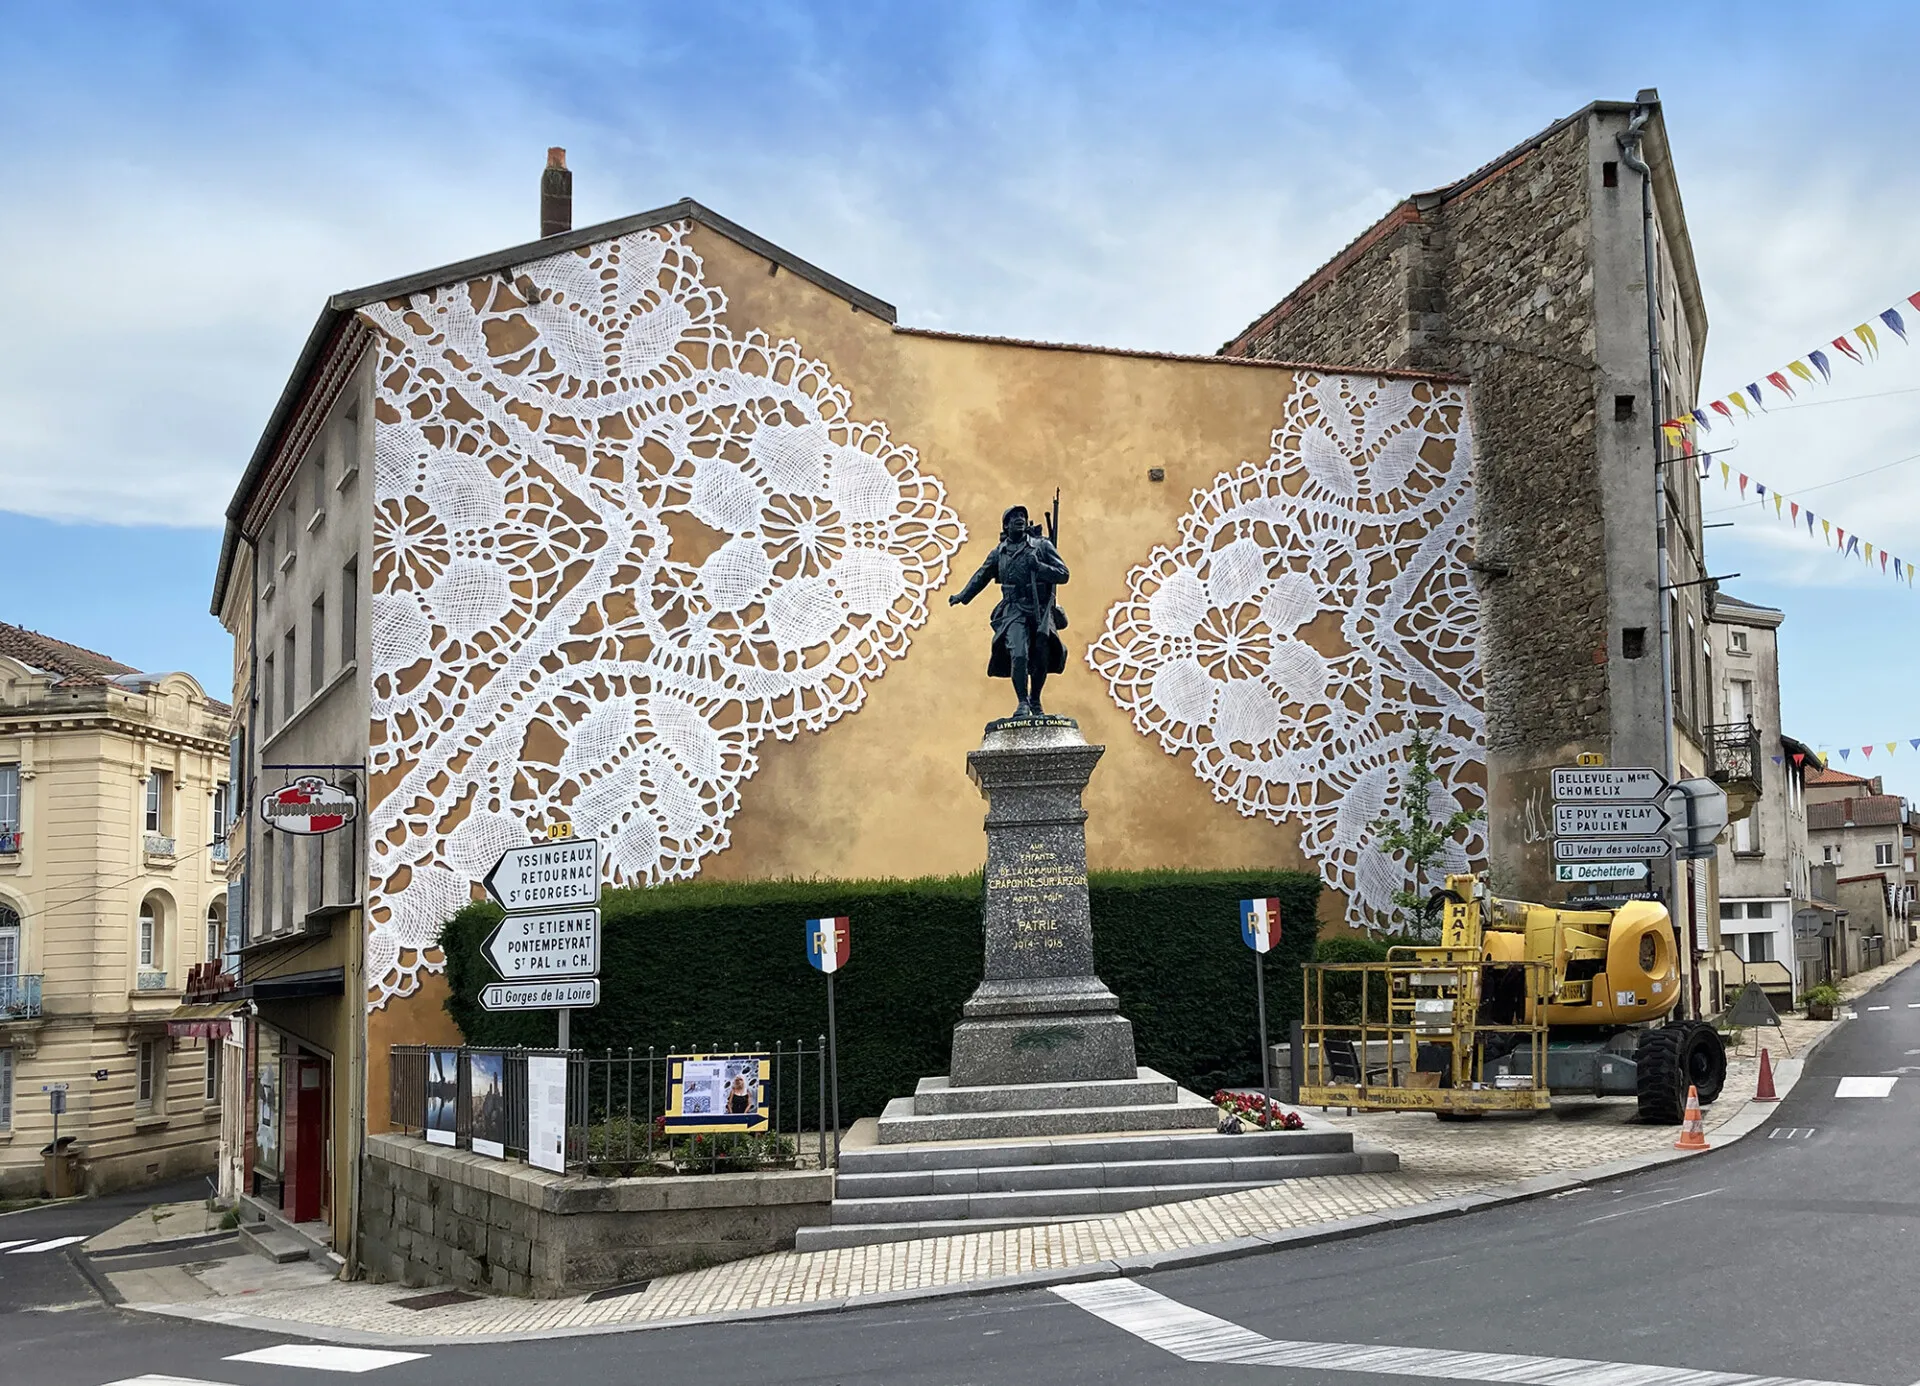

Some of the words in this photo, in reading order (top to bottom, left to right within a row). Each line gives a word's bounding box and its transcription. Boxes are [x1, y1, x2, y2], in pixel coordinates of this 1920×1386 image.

[1584, 755, 1591, 765] D
[1593, 755, 1599, 765] 1
[1558, 773, 1612, 784] BELLEVUE
[1558, 785, 1621, 796] CHOMELIX
[266, 797, 354, 820] Kronenbourg
[1559, 809, 1573, 820] LE
[1577, 809, 1599, 820] PUY
[1617, 808, 1652, 819] VELAY
[552, 825, 559, 838] D
[561, 824, 568, 836] 9
[1577, 821, 1628, 832] PAULIEN
[517, 847, 592, 868] YSSINGEAUX
[1577, 845, 1603, 857] Velay
[1606, 844, 1622, 854] des
[1626, 844, 1661, 854] volcans
[521, 865, 592, 884] RETOURNAC
[1578, 865, 1635, 878] Déchetterie
[524, 883, 592, 901] GEORGES-L.
[539, 918, 591, 934] ETIENNE
[1018, 920, 1058, 931] PATRIE
[1452, 907, 1466, 947] HA1
[508, 936, 591, 953] PONTEMPEYRAT
[530, 956, 551, 969] PAL
[556, 959, 567, 968] EN
[572, 953, 591, 967] CH.
[505, 990, 538, 1005] Gorges
[541, 988, 553, 1001] de
[555, 988, 564, 1001] la
[567, 986, 591, 1000] Loire
